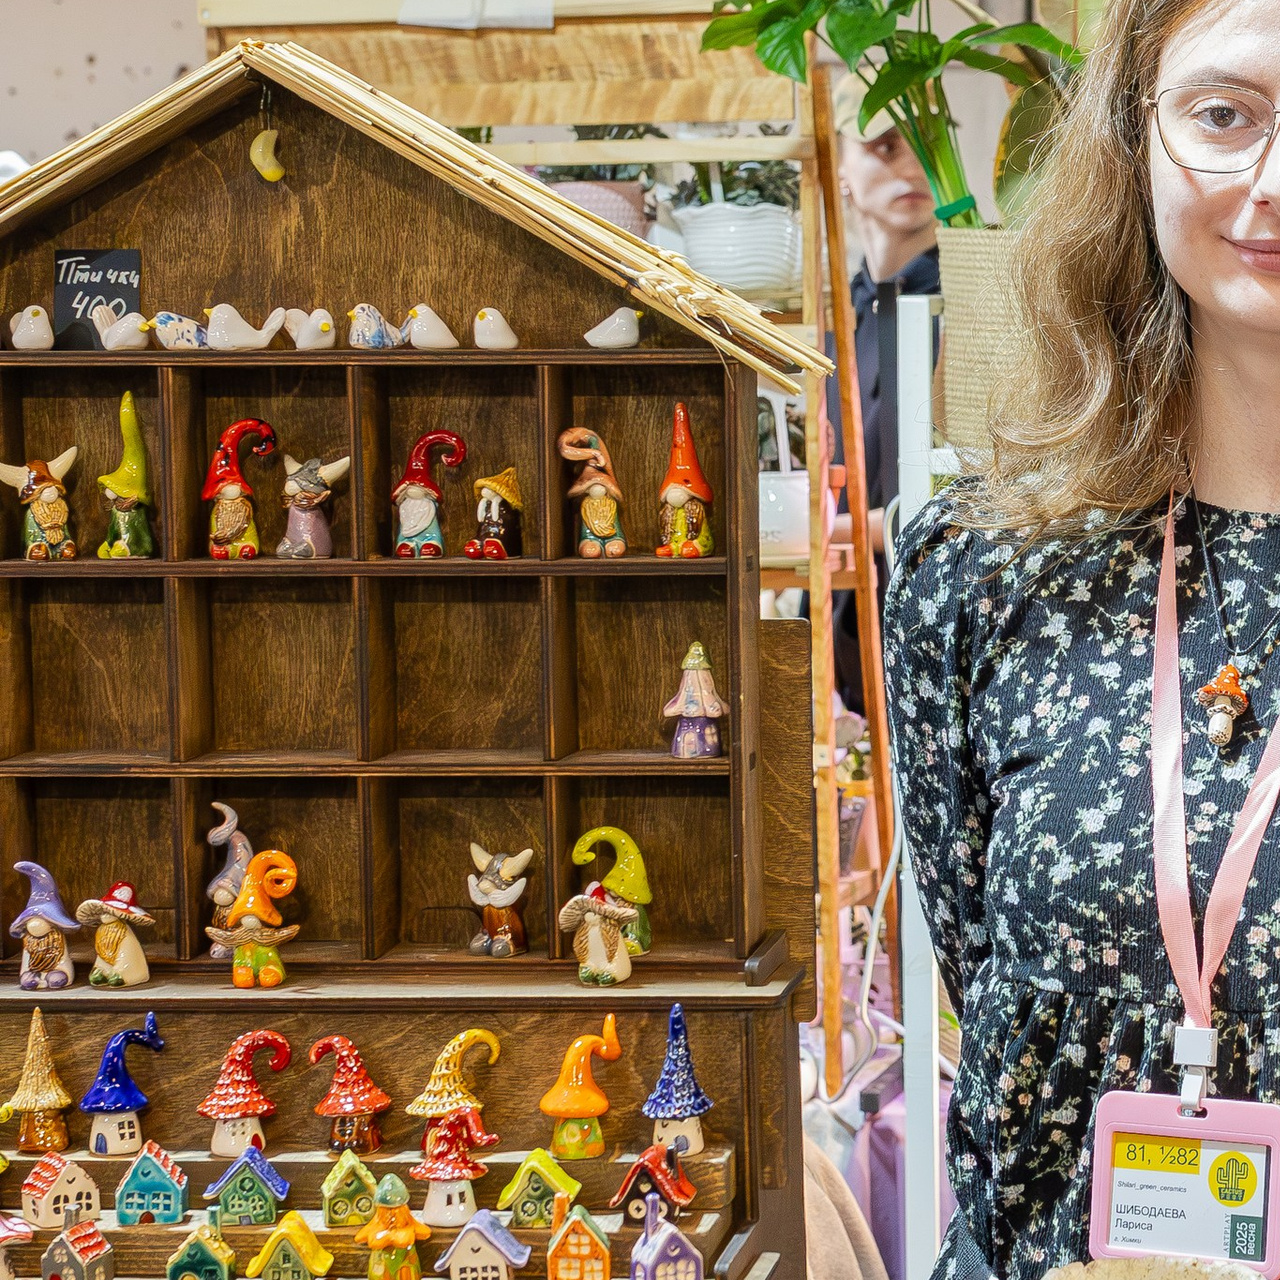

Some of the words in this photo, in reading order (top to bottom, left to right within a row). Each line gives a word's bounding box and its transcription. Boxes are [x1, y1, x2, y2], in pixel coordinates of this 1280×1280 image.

[72, 291, 127, 320] 400
[1126, 1143, 1151, 1165] 81,
[1115, 1218, 1153, 1231] Лариса
[1116, 1204, 1187, 1220] ШИБОДАЕВА
[1223, 1213, 1232, 1253] ARTPLAY
[1235, 1222, 1248, 1255] 2025
